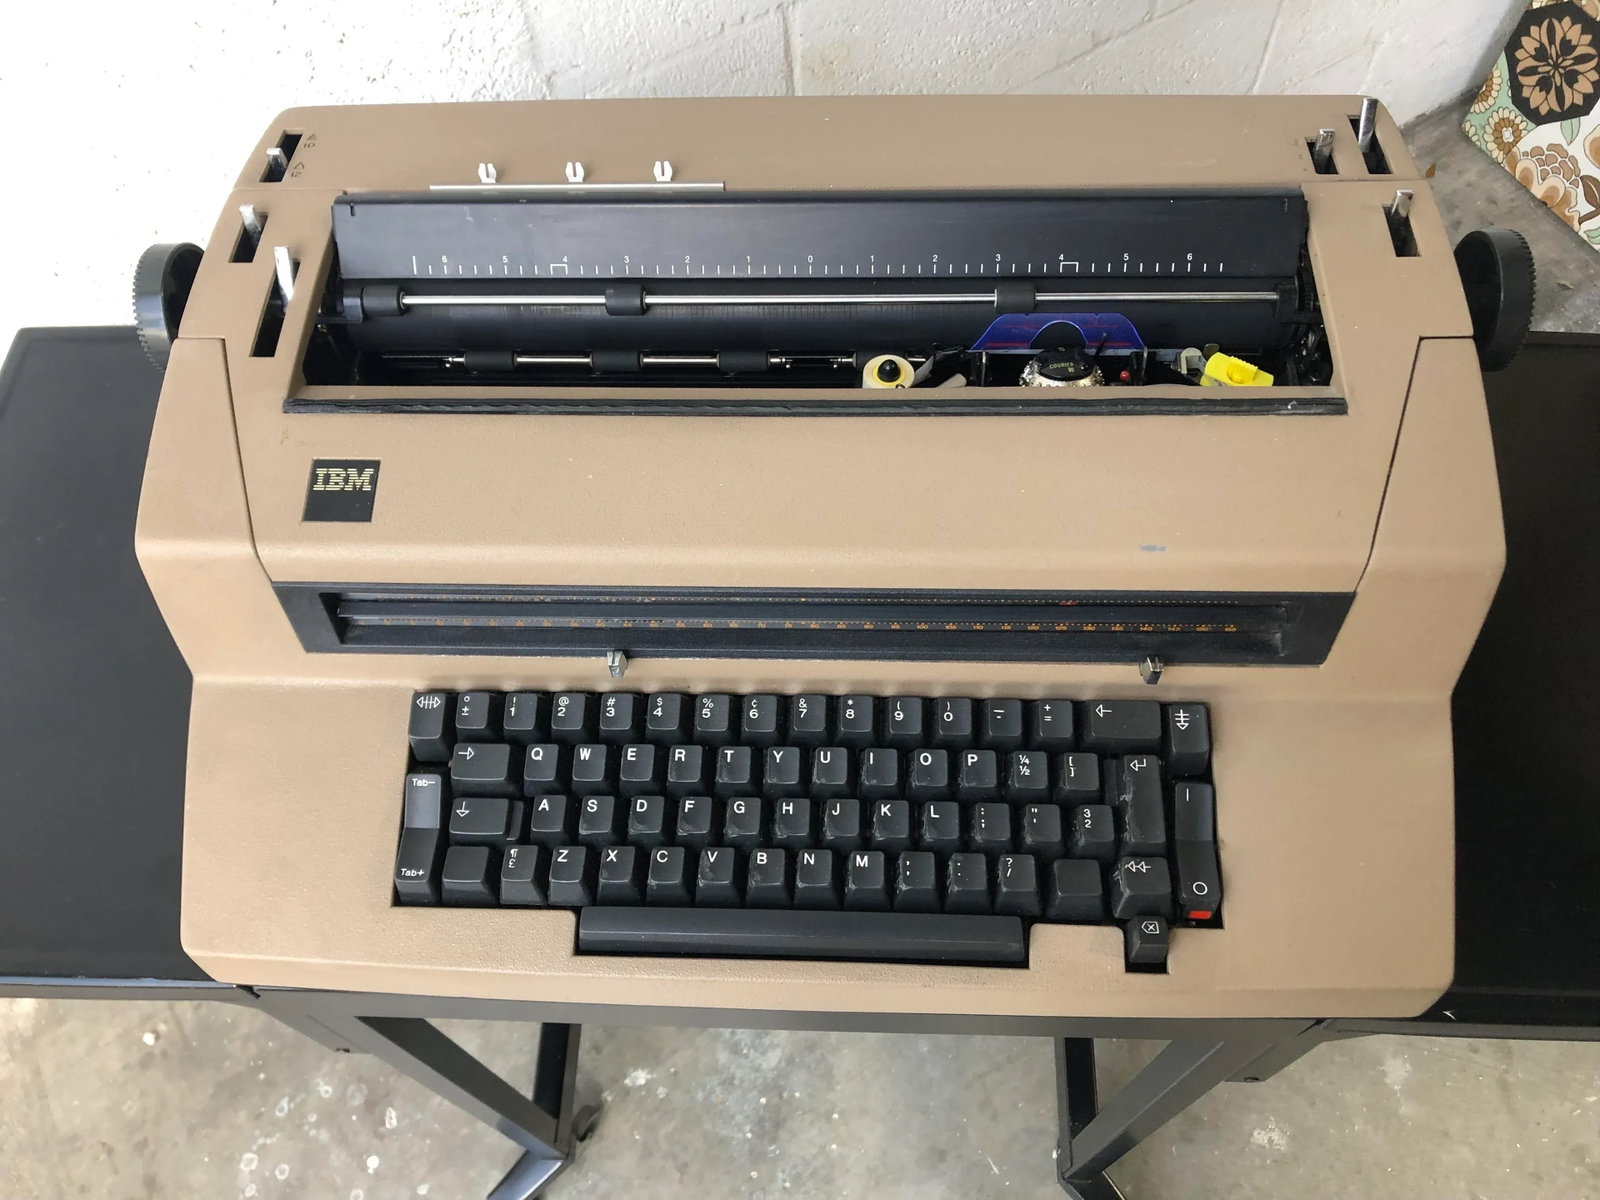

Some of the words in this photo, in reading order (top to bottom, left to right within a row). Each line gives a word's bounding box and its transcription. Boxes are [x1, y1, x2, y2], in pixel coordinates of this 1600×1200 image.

[442, 255, 448, 264] 6
[503, 255, 508, 264] 5
[562, 255, 568, 264] 4
[624, 255, 629, 264] 3
[685, 255, 690, 264] 2
[746, 255, 750, 264] 1
[808, 254, 813, 263] 0
[870, 254, 874, 263] 1
[932, 254, 938, 263] 2
[995, 253, 1000, 262] 3
[1059, 252, 1064, 261] 4
[1124, 252, 1129, 261] 5
[1187, 252, 1193, 261] 6
[313, 468, 374, 491] IBM
[558, 696, 570, 707] @
[606, 696, 617, 707] #
[656, 697, 663, 707] $
[702, 697, 714, 709] %
[798, 697, 808, 709] &
[1043, 703, 1052, 712] +
[509, 706, 516, 717] 1
[557, 706, 567, 717] 2
[605, 706, 616, 717] 3
[652, 706, 663, 717] 4
[701, 708, 711, 719] 5
[749, 708, 759, 719] 6
[798, 708, 808, 719] 7
[845, 708, 855, 719] 8
[894, 710, 904, 721] 9
[530, 747, 544, 762] Q
[579, 747, 592, 761] W
[626, 747, 638, 761] E
[674, 748, 687, 762] R
[723, 749, 735, 763] T
[772, 750, 784, 764] Y
[820, 750, 831, 764] U
[869, 751, 874, 765] I
[919, 752, 932, 766] O
[967, 753, 978, 767] P
[1068, 756, 1074, 767] [
[1069, 766, 1075, 777] ]
[537, 798, 550, 812] A
[586, 799, 598, 813] S
[636, 799, 648, 812] D
[684, 800, 696, 813] F
[733, 800, 746, 814] G
[782, 801, 794, 815] H
[831, 802, 840, 816] J
[880, 803, 892, 817] K
[930, 805, 940, 818] L
[556, 849, 569, 863] Z
[606, 849, 618, 863] X
[656, 850, 669, 863] C
[707, 850, 719, 863] V
[756, 851, 768, 865] B
[803, 852, 816, 866] N
[855, 854, 869, 868] M
[1005, 856, 1013, 867] ?
